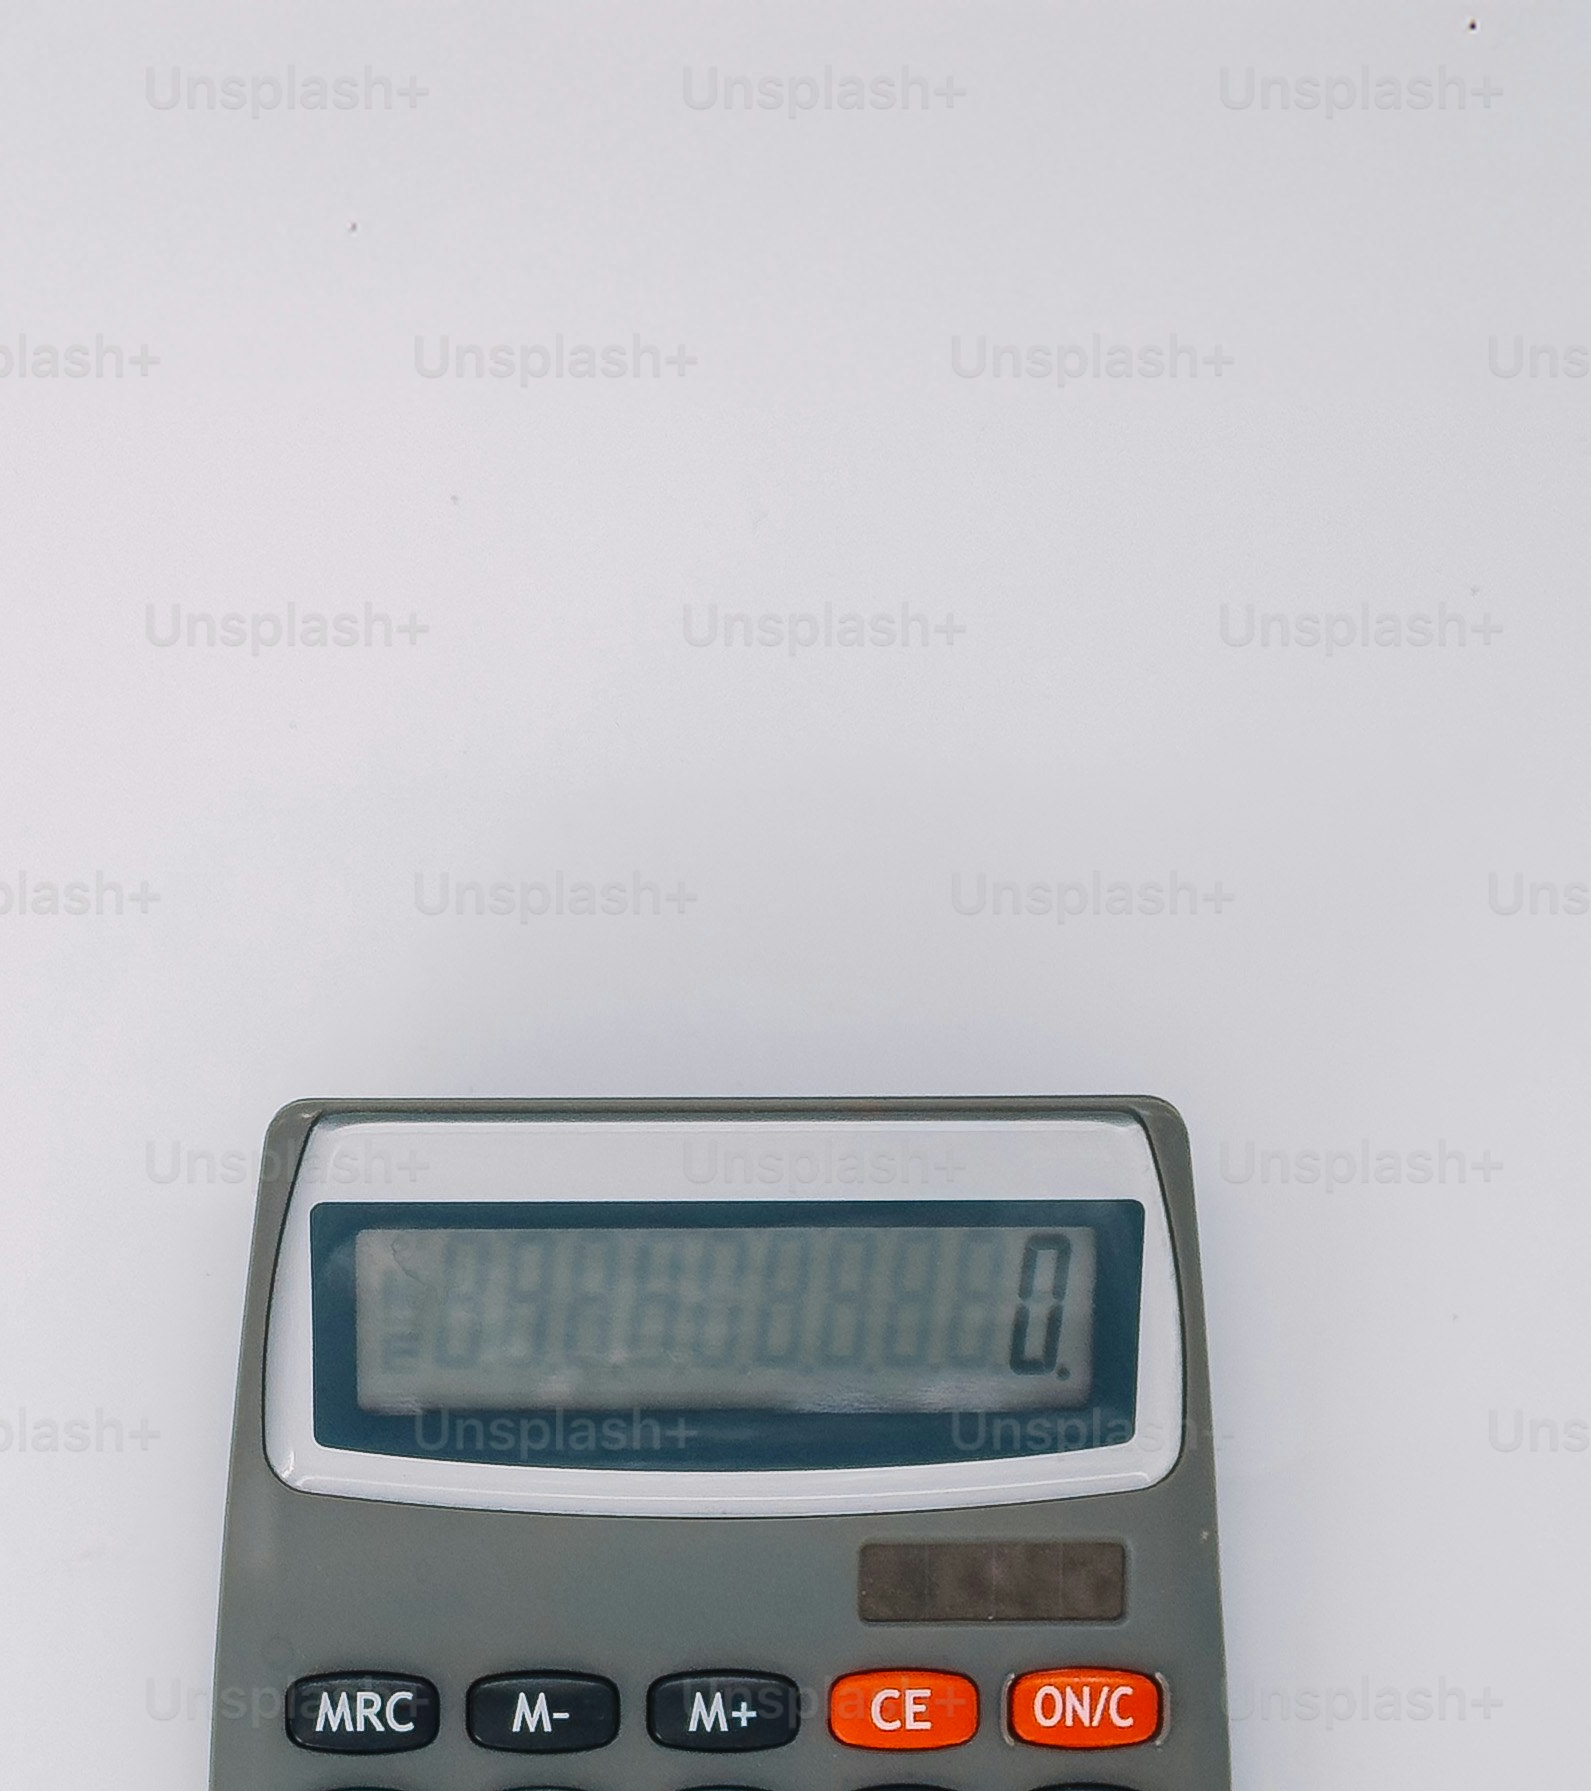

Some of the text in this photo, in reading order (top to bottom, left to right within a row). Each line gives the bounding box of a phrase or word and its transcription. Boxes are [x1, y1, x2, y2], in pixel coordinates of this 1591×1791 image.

[314, 1690, 416, 1733] MRC
[511, 1691, 571, 1734] M-
[687, 1690, 758, 1733] M+
[870, 1688, 932, 1732] CE
[1033, 1684, 1134, 1728] ON/C
